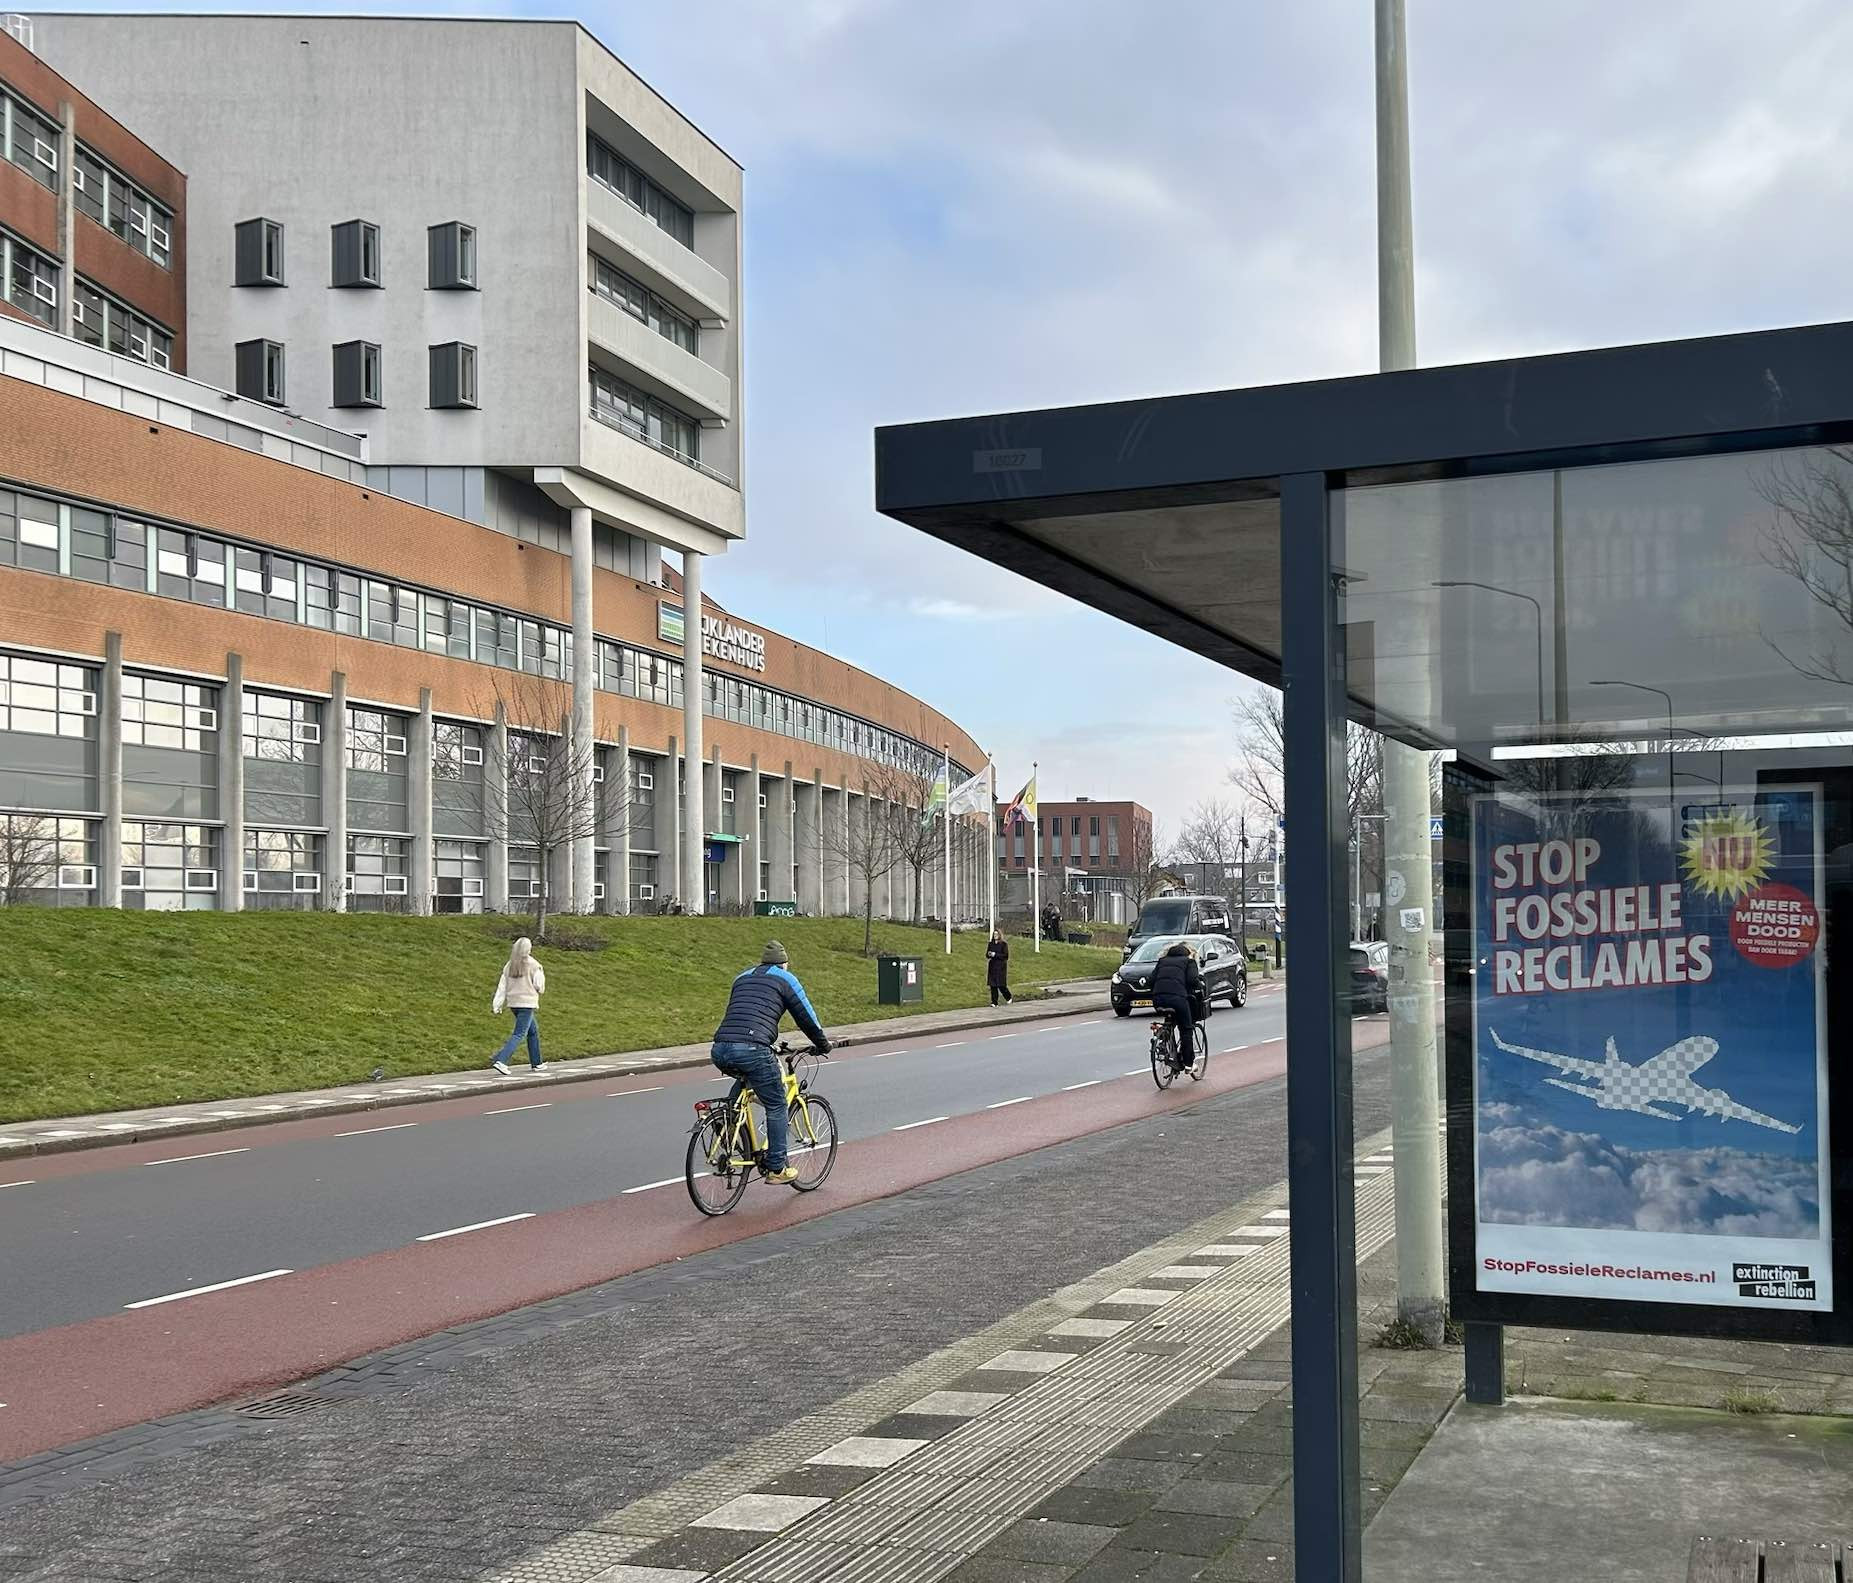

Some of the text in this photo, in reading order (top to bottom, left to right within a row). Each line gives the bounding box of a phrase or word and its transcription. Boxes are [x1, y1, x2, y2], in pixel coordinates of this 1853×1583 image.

[1493, 838, 1601, 890] STOP
[1702, 836, 1753, 871] NU
[1495, 884, 1682, 942] FOSSIELE
[1750, 899, 1802, 912] MEER
[1736, 911, 1814, 926] MENSEN
[1748, 924, 1801, 938] DOOD
[1496, 935, 1713, 993] RECLAMES
[1484, 1258, 1715, 1283] StopFossieleReclames.nl
[1736, 1265, 1799, 1280] extinction
[1755, 1280, 1813, 1298] rebellion
